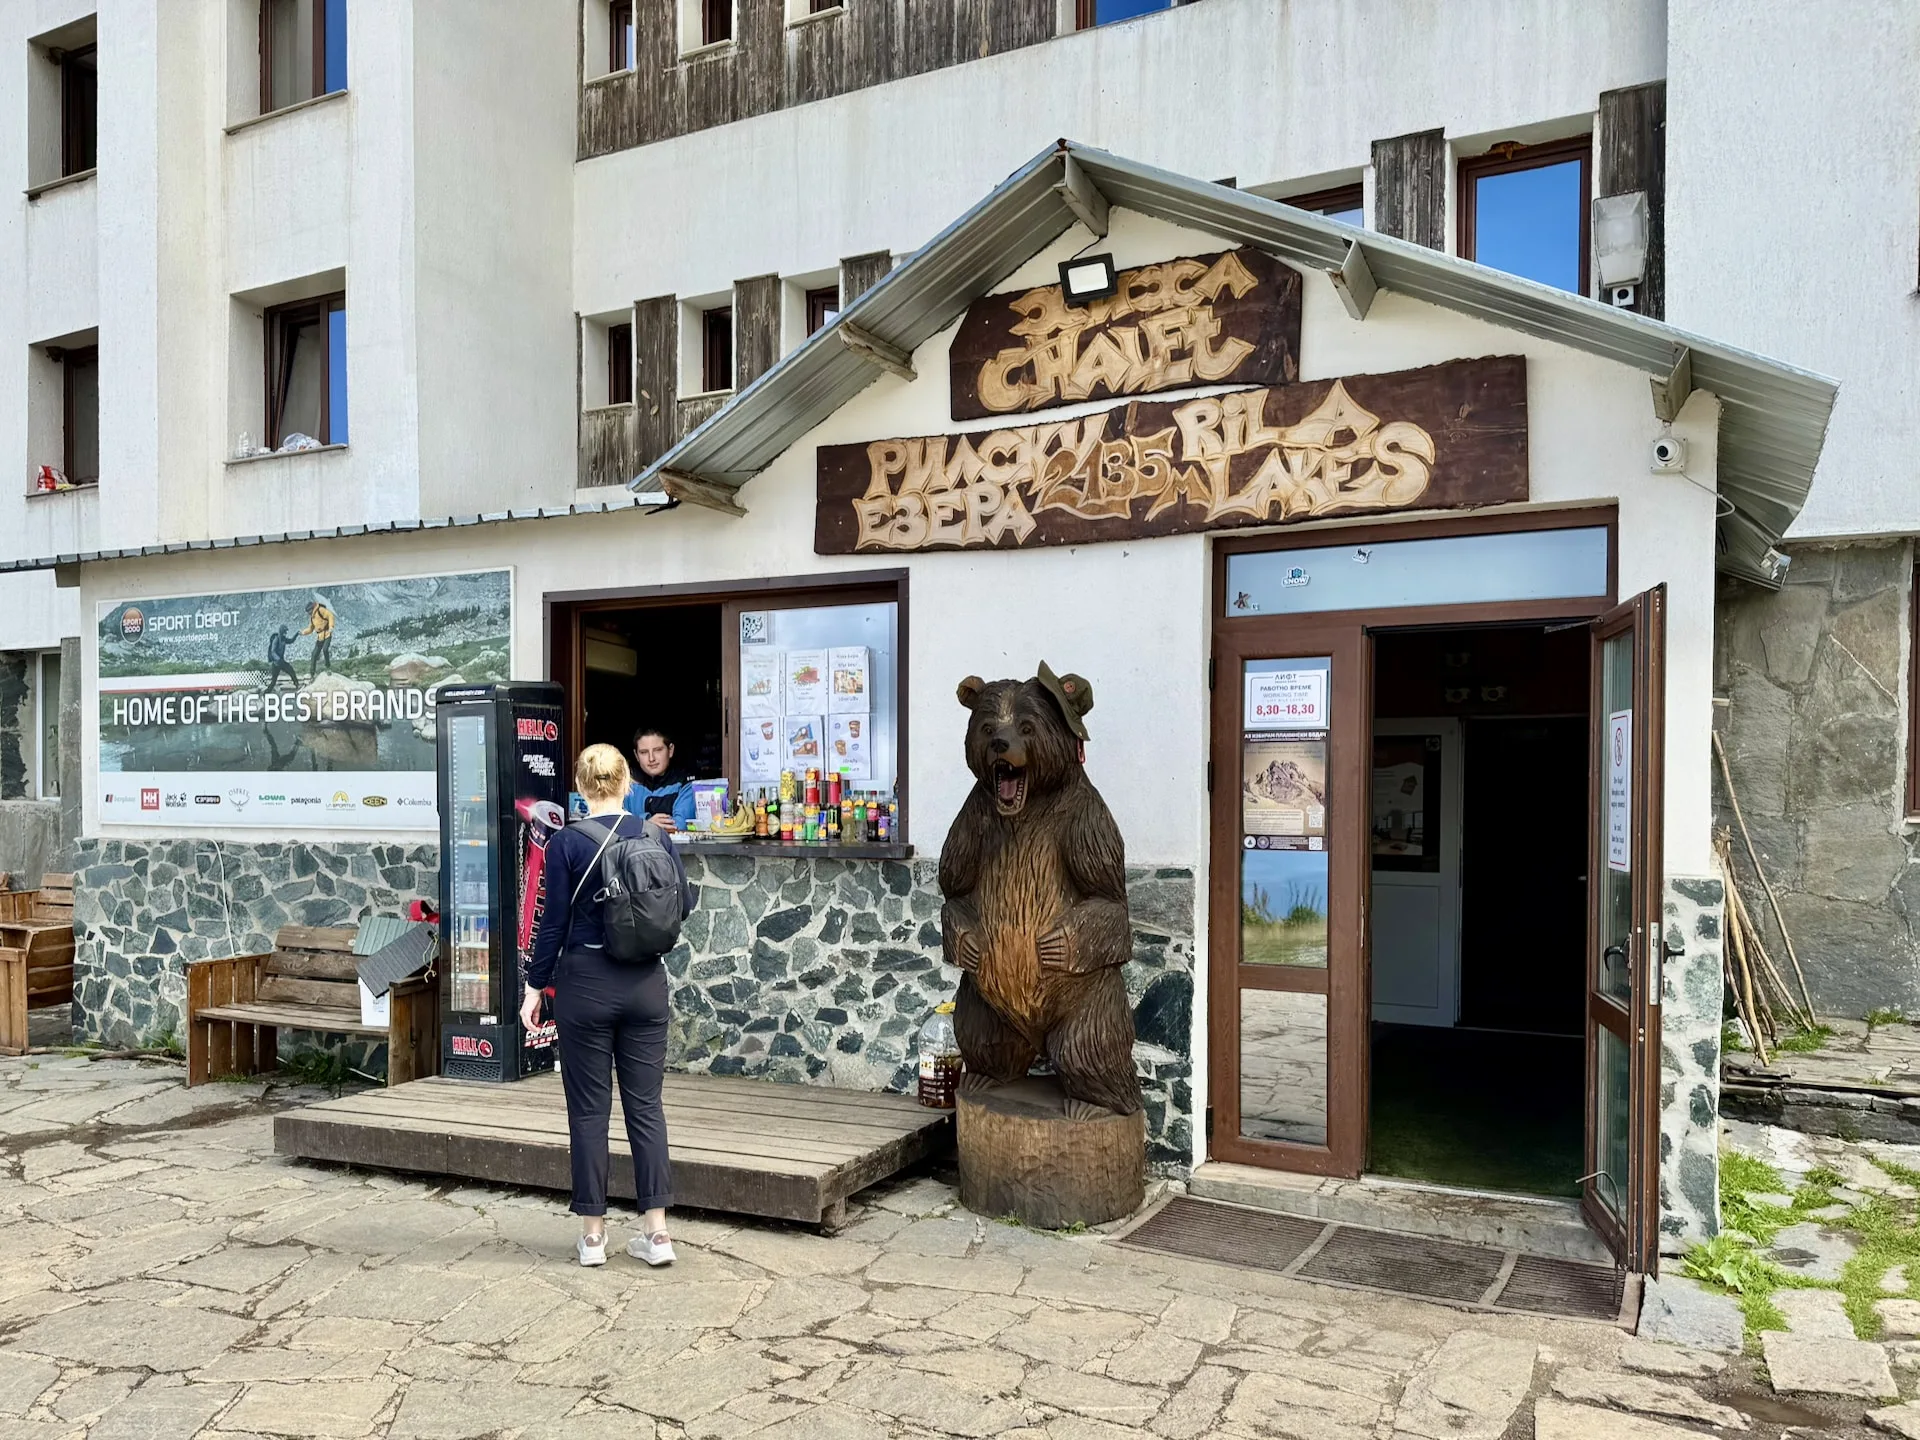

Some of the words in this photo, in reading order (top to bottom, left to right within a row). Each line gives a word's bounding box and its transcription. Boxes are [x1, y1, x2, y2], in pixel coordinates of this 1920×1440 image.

[863, 413, 1109, 500] РИЛСКИ
[1203, 421, 1436, 522] LAKES
[852, 482, 1037, 550] ЕЗЕРА
[1283, 577, 1307, 585] SNOW
[122, 618, 142, 626] SPORT
[149, 615, 192, 632] SPORT
[195, 610, 240, 629] DEPOT
[124, 626, 141, 634] 2000
[159, 632, 218, 643] www.sportdepot.bg
[1275, 673, 1297, 681] ЛИФТ
[113, 697, 176, 726] HOME
[180, 695, 211, 725] OF
[213, 693, 260, 724] THE
[264, 691, 331, 723] BEST
[332, 688, 436, 721] BRANDS
[517, 718, 545, 737] HELL
[523, 754, 544, 763] GIVES
[529, 761, 554, 770] POWER
[539, 768, 556, 777] HELL
[166, 793, 178, 801] Jack
[291, 797, 322, 805] patagonia
[364, 797, 387, 805] KEEN
[165, 800, 187, 808] Wolfskin
[403, 798, 432, 806] Columbia
[452, 1036, 478, 1052] HELL
